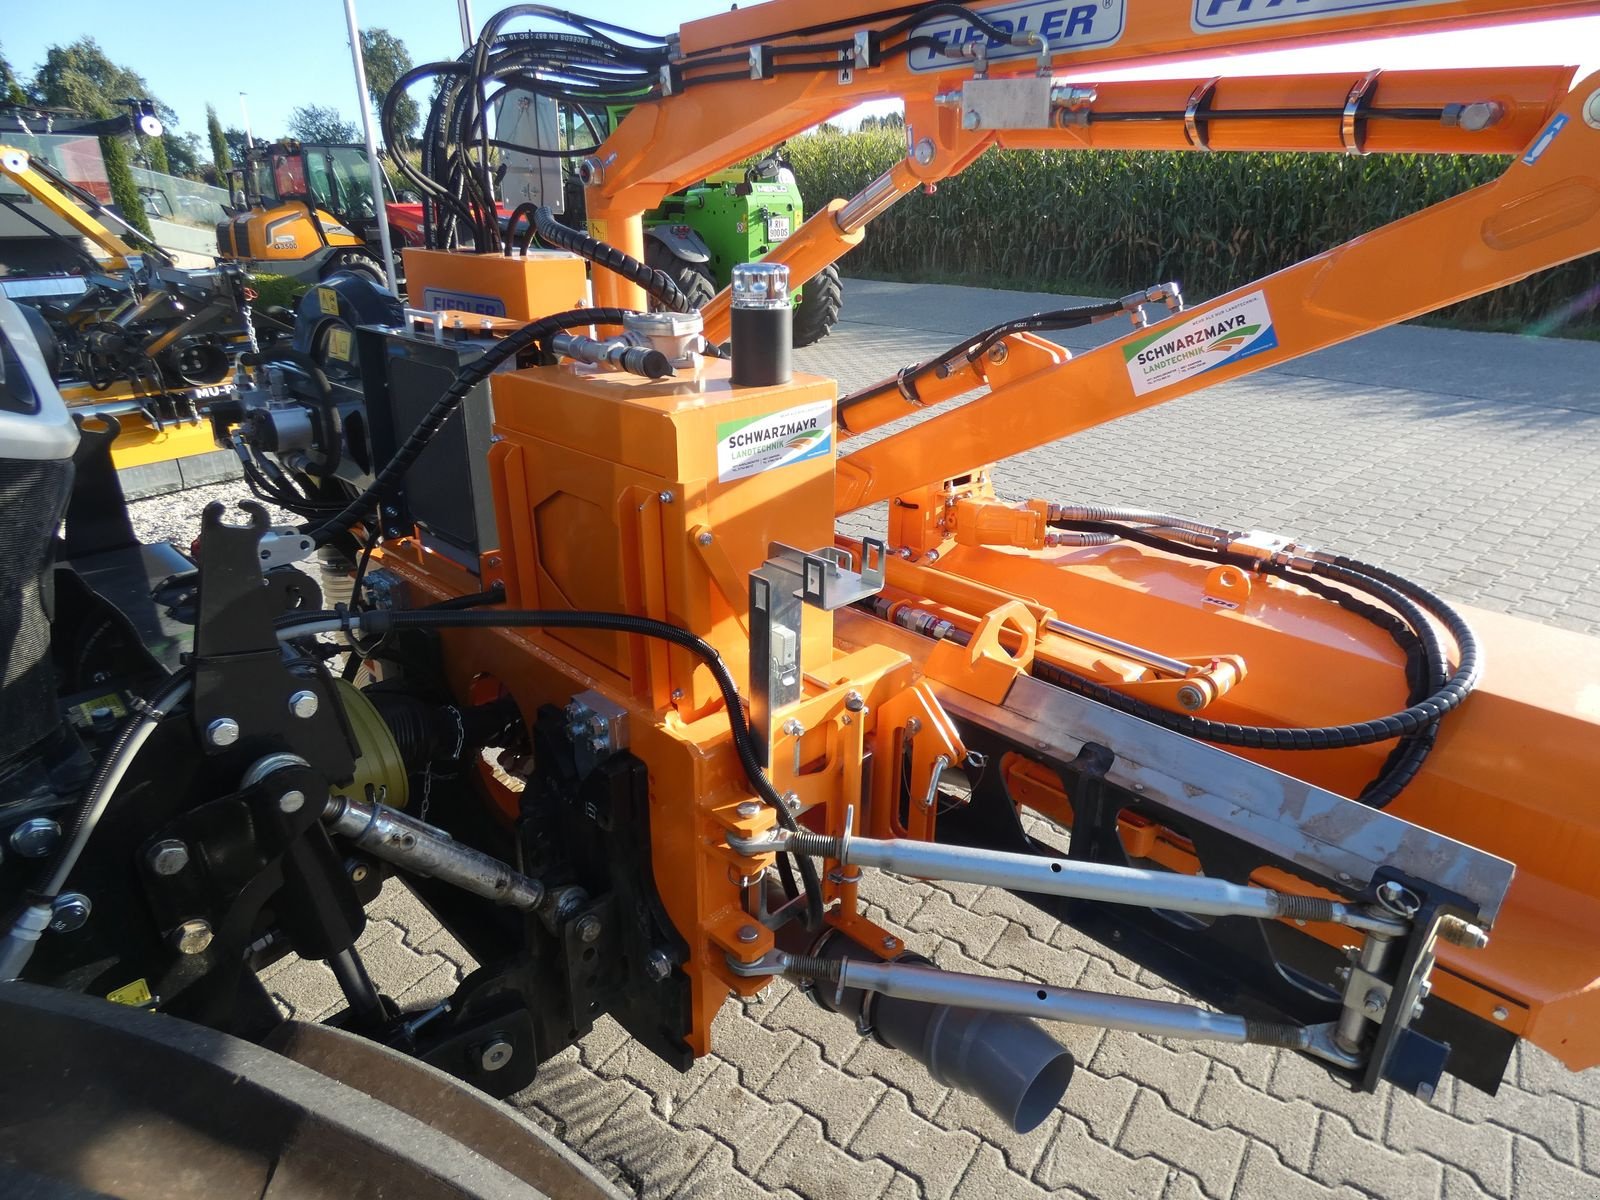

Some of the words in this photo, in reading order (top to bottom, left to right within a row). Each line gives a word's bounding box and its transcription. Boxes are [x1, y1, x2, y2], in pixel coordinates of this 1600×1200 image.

[1137, 314, 1247, 366] SCHWARZMAYR
[1143, 346, 1206, 375] LANDTECHNIK
[728, 418, 818, 449] SCHWARZMAYR
[731, 440, 785, 460] LANDTECHNIK
